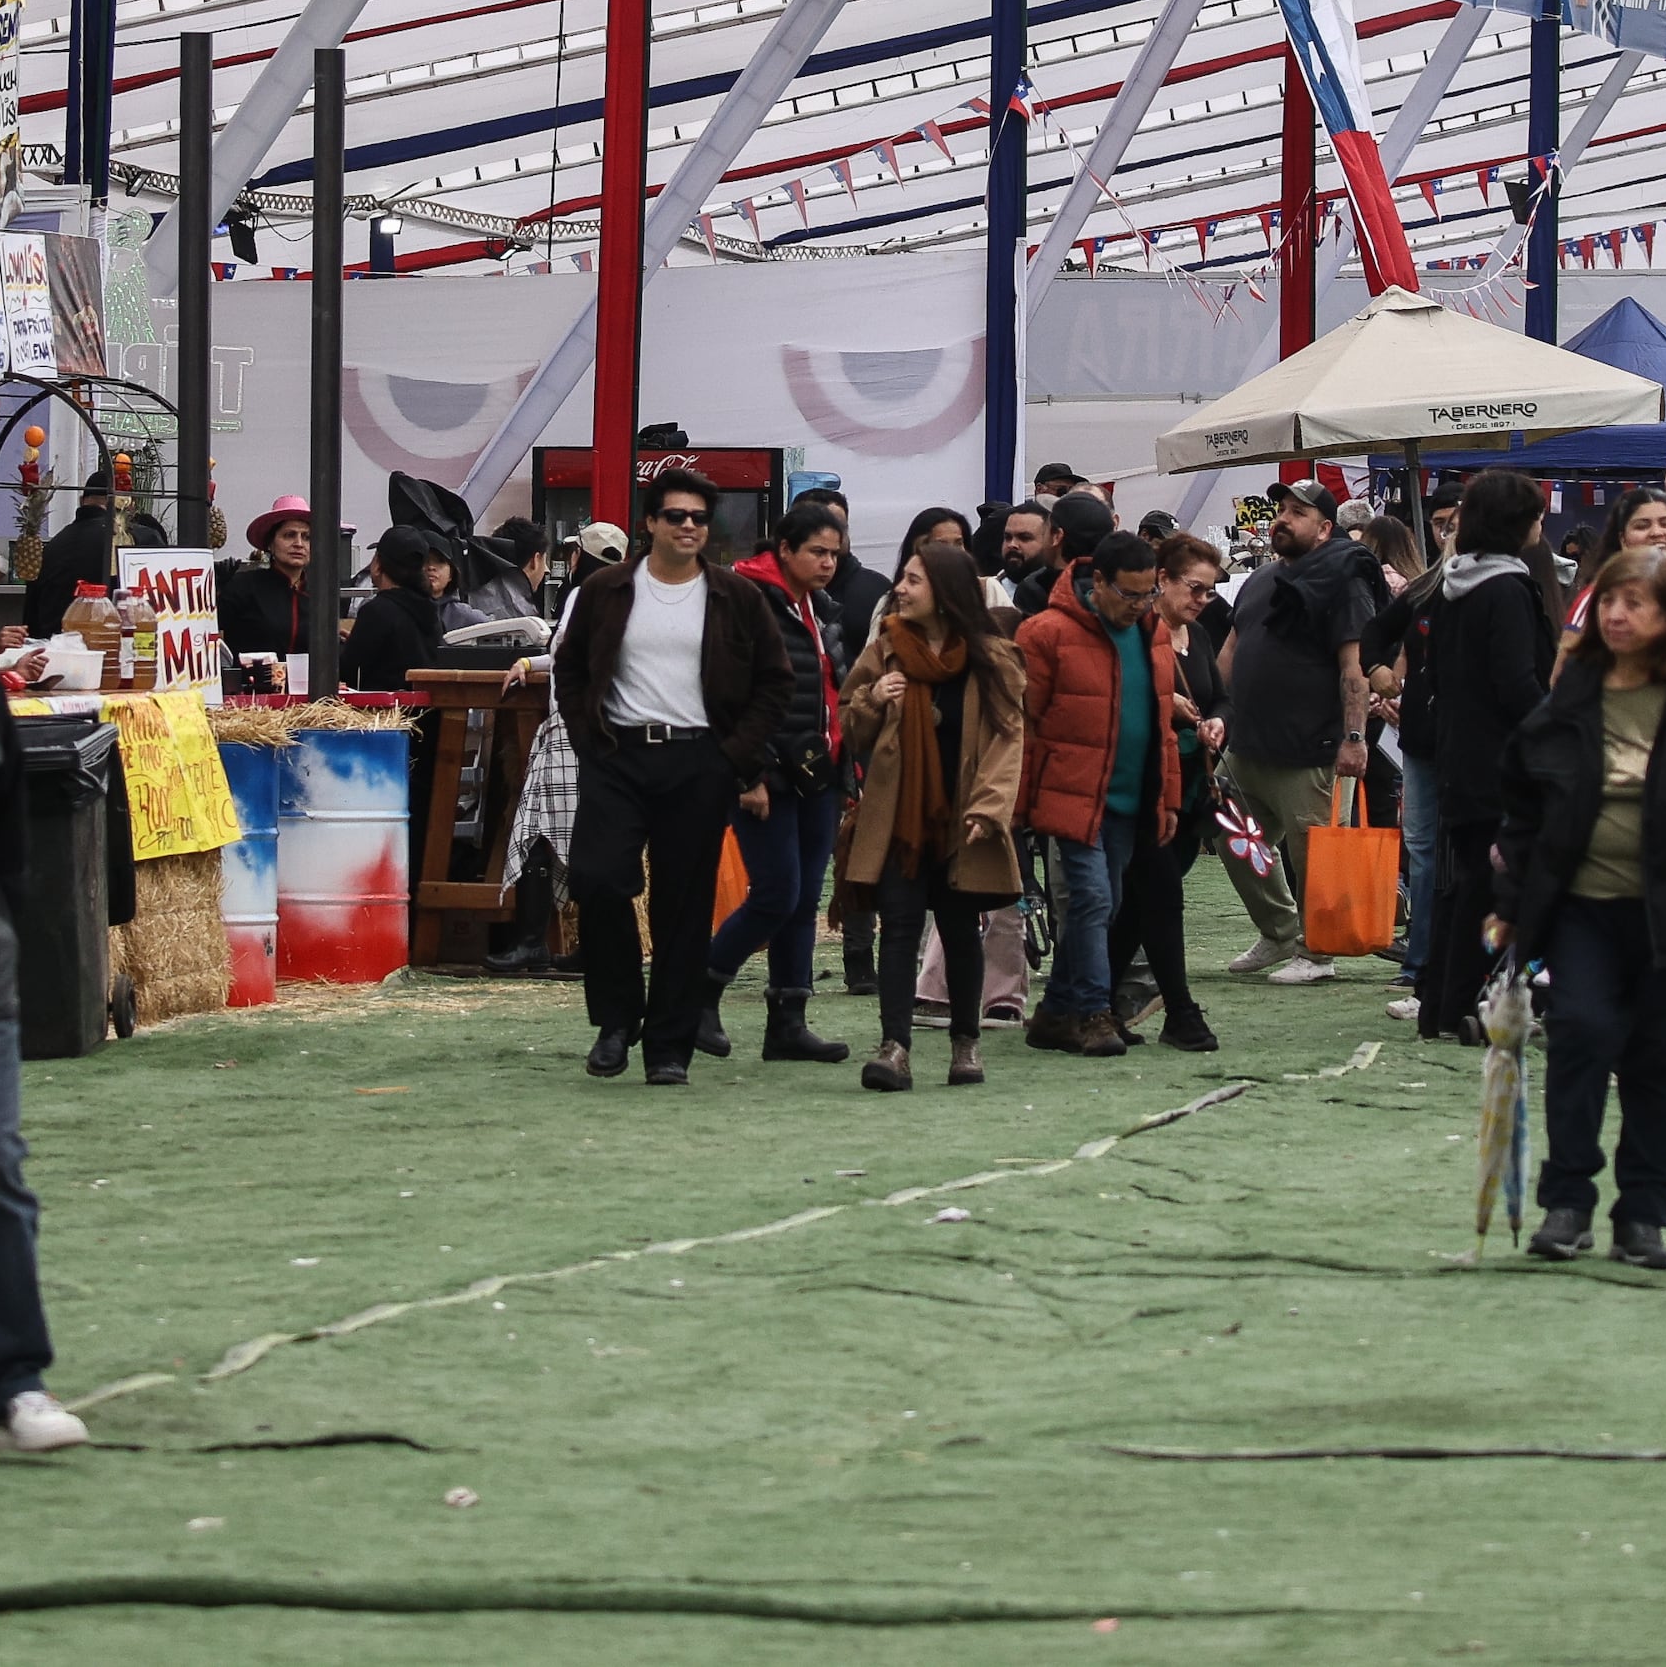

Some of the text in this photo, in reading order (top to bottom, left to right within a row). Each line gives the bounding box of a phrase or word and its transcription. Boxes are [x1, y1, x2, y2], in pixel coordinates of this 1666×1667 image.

[1428, 402, 1539, 424] TABERNERO
[1455, 420, 1512, 430] DESDE 1897
[1204, 428, 1249, 450] TABERNERO
